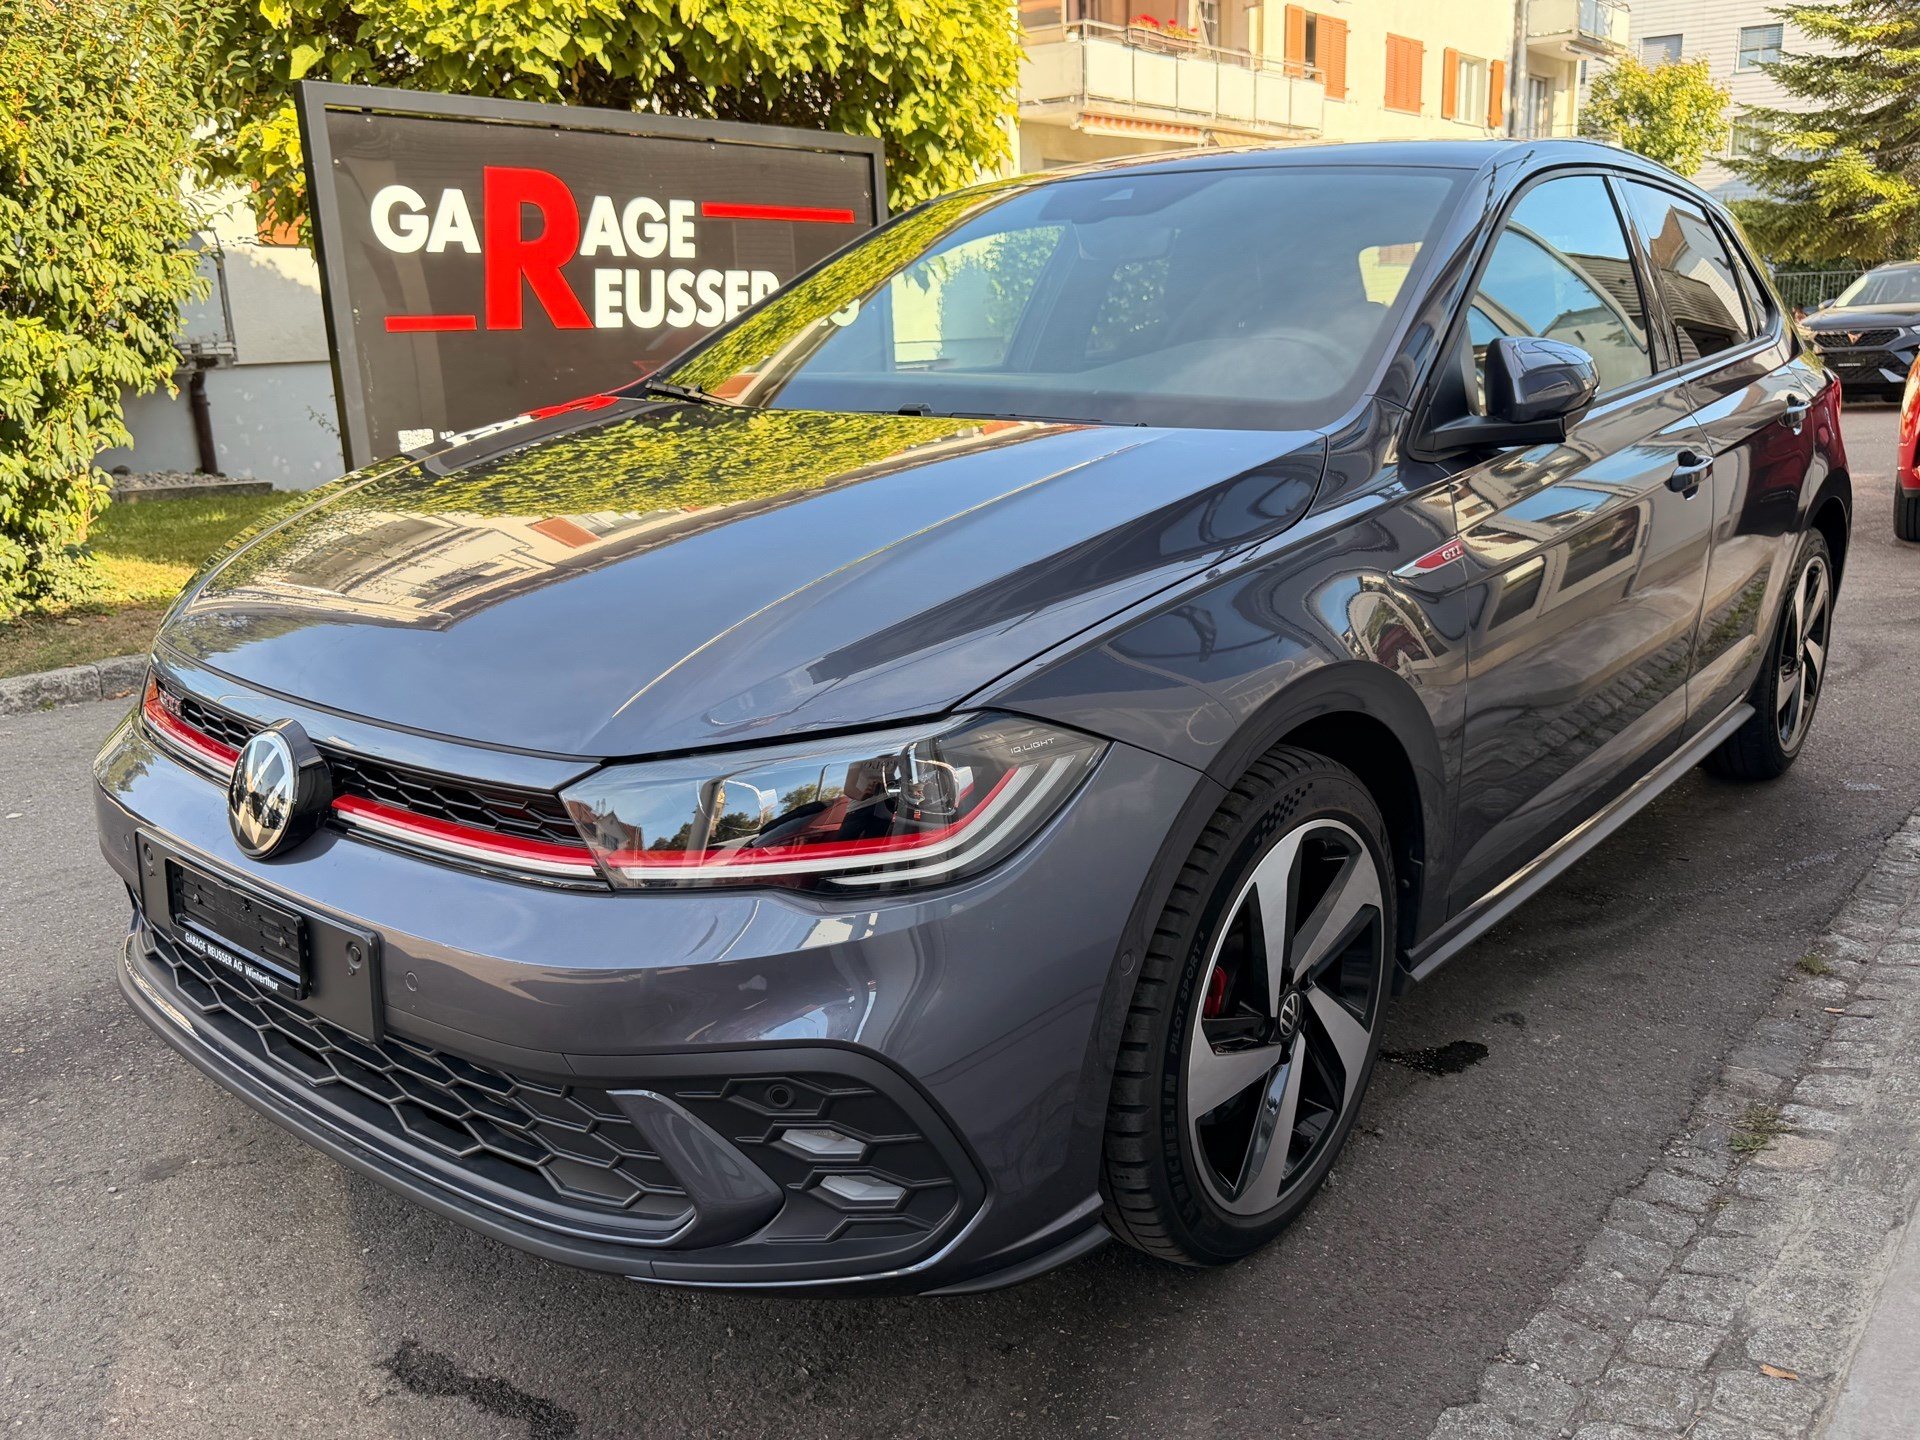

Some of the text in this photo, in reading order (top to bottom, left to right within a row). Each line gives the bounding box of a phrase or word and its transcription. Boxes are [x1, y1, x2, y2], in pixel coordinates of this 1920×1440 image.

[371, 165, 696, 330] GARAGE
[1441, 545, 1461, 561] GTI
[1010, 737, 1055, 754] IQ.LIGHT
[184, 932, 279, 991] GARAGE REUSSER AG Winterthur
[1163, 943, 1201, 1204] MICHELIN PILOT SPORT
